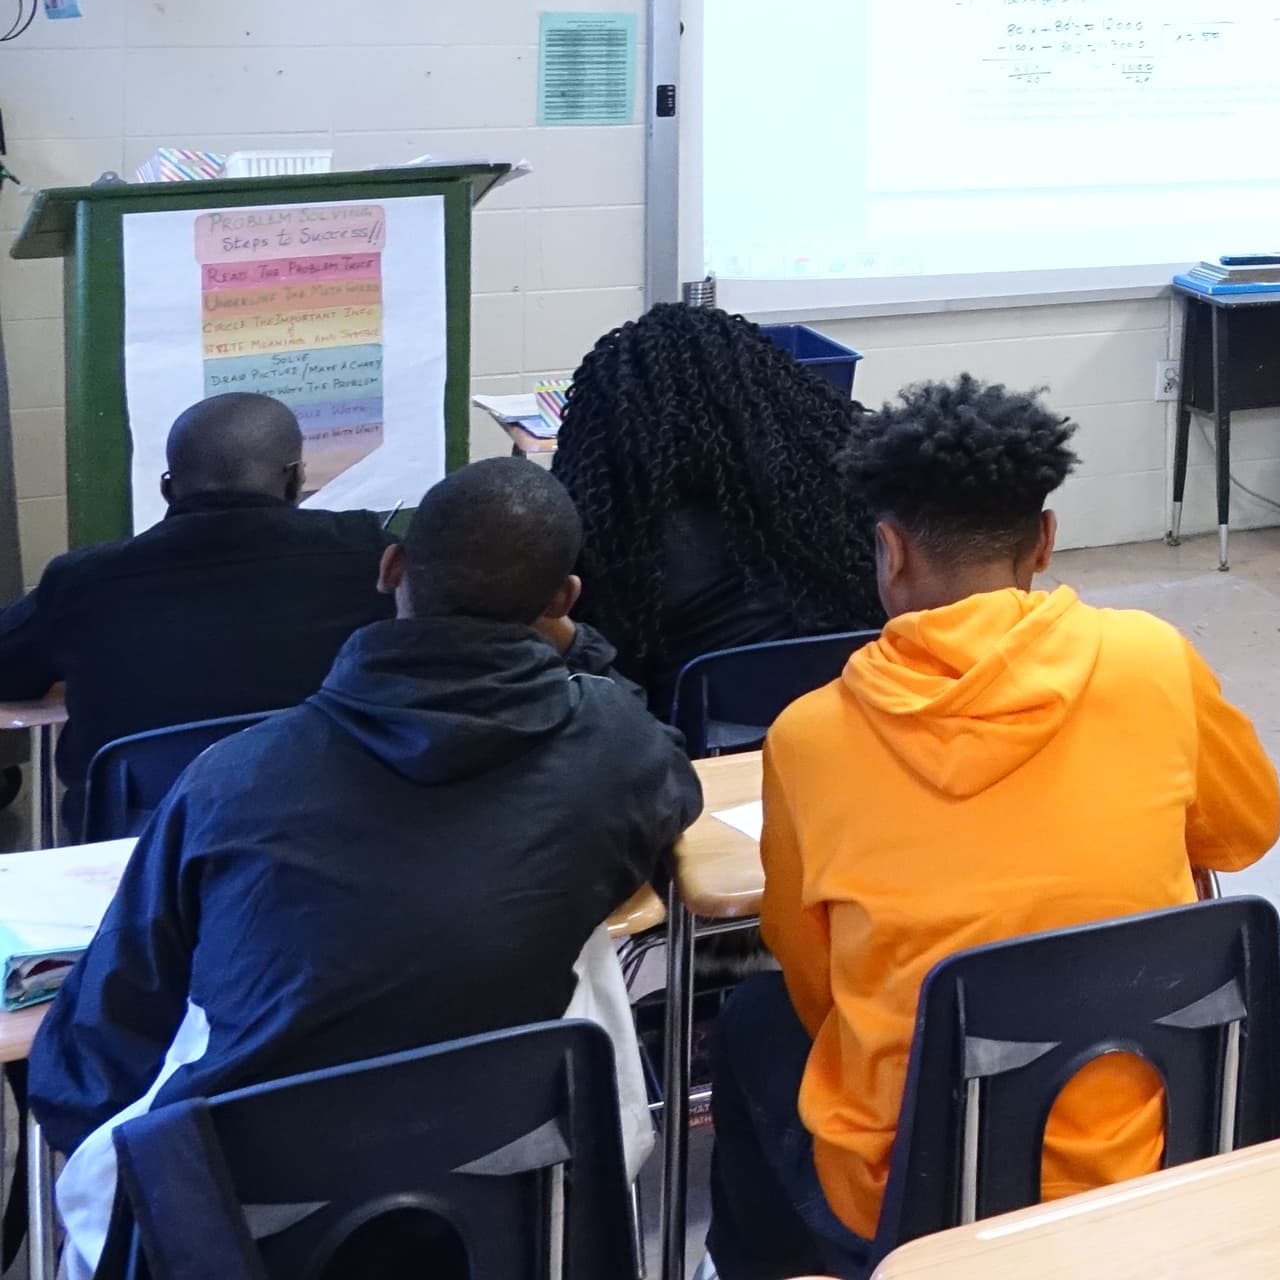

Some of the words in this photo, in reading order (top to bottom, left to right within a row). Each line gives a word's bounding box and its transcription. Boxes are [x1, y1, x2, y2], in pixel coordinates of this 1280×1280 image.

[208, 211, 291, 233] PROBLEM
[222, 236, 268, 252] Steps
[277, 228, 290, 246] to
[272, 352, 310, 366] SOLVE
